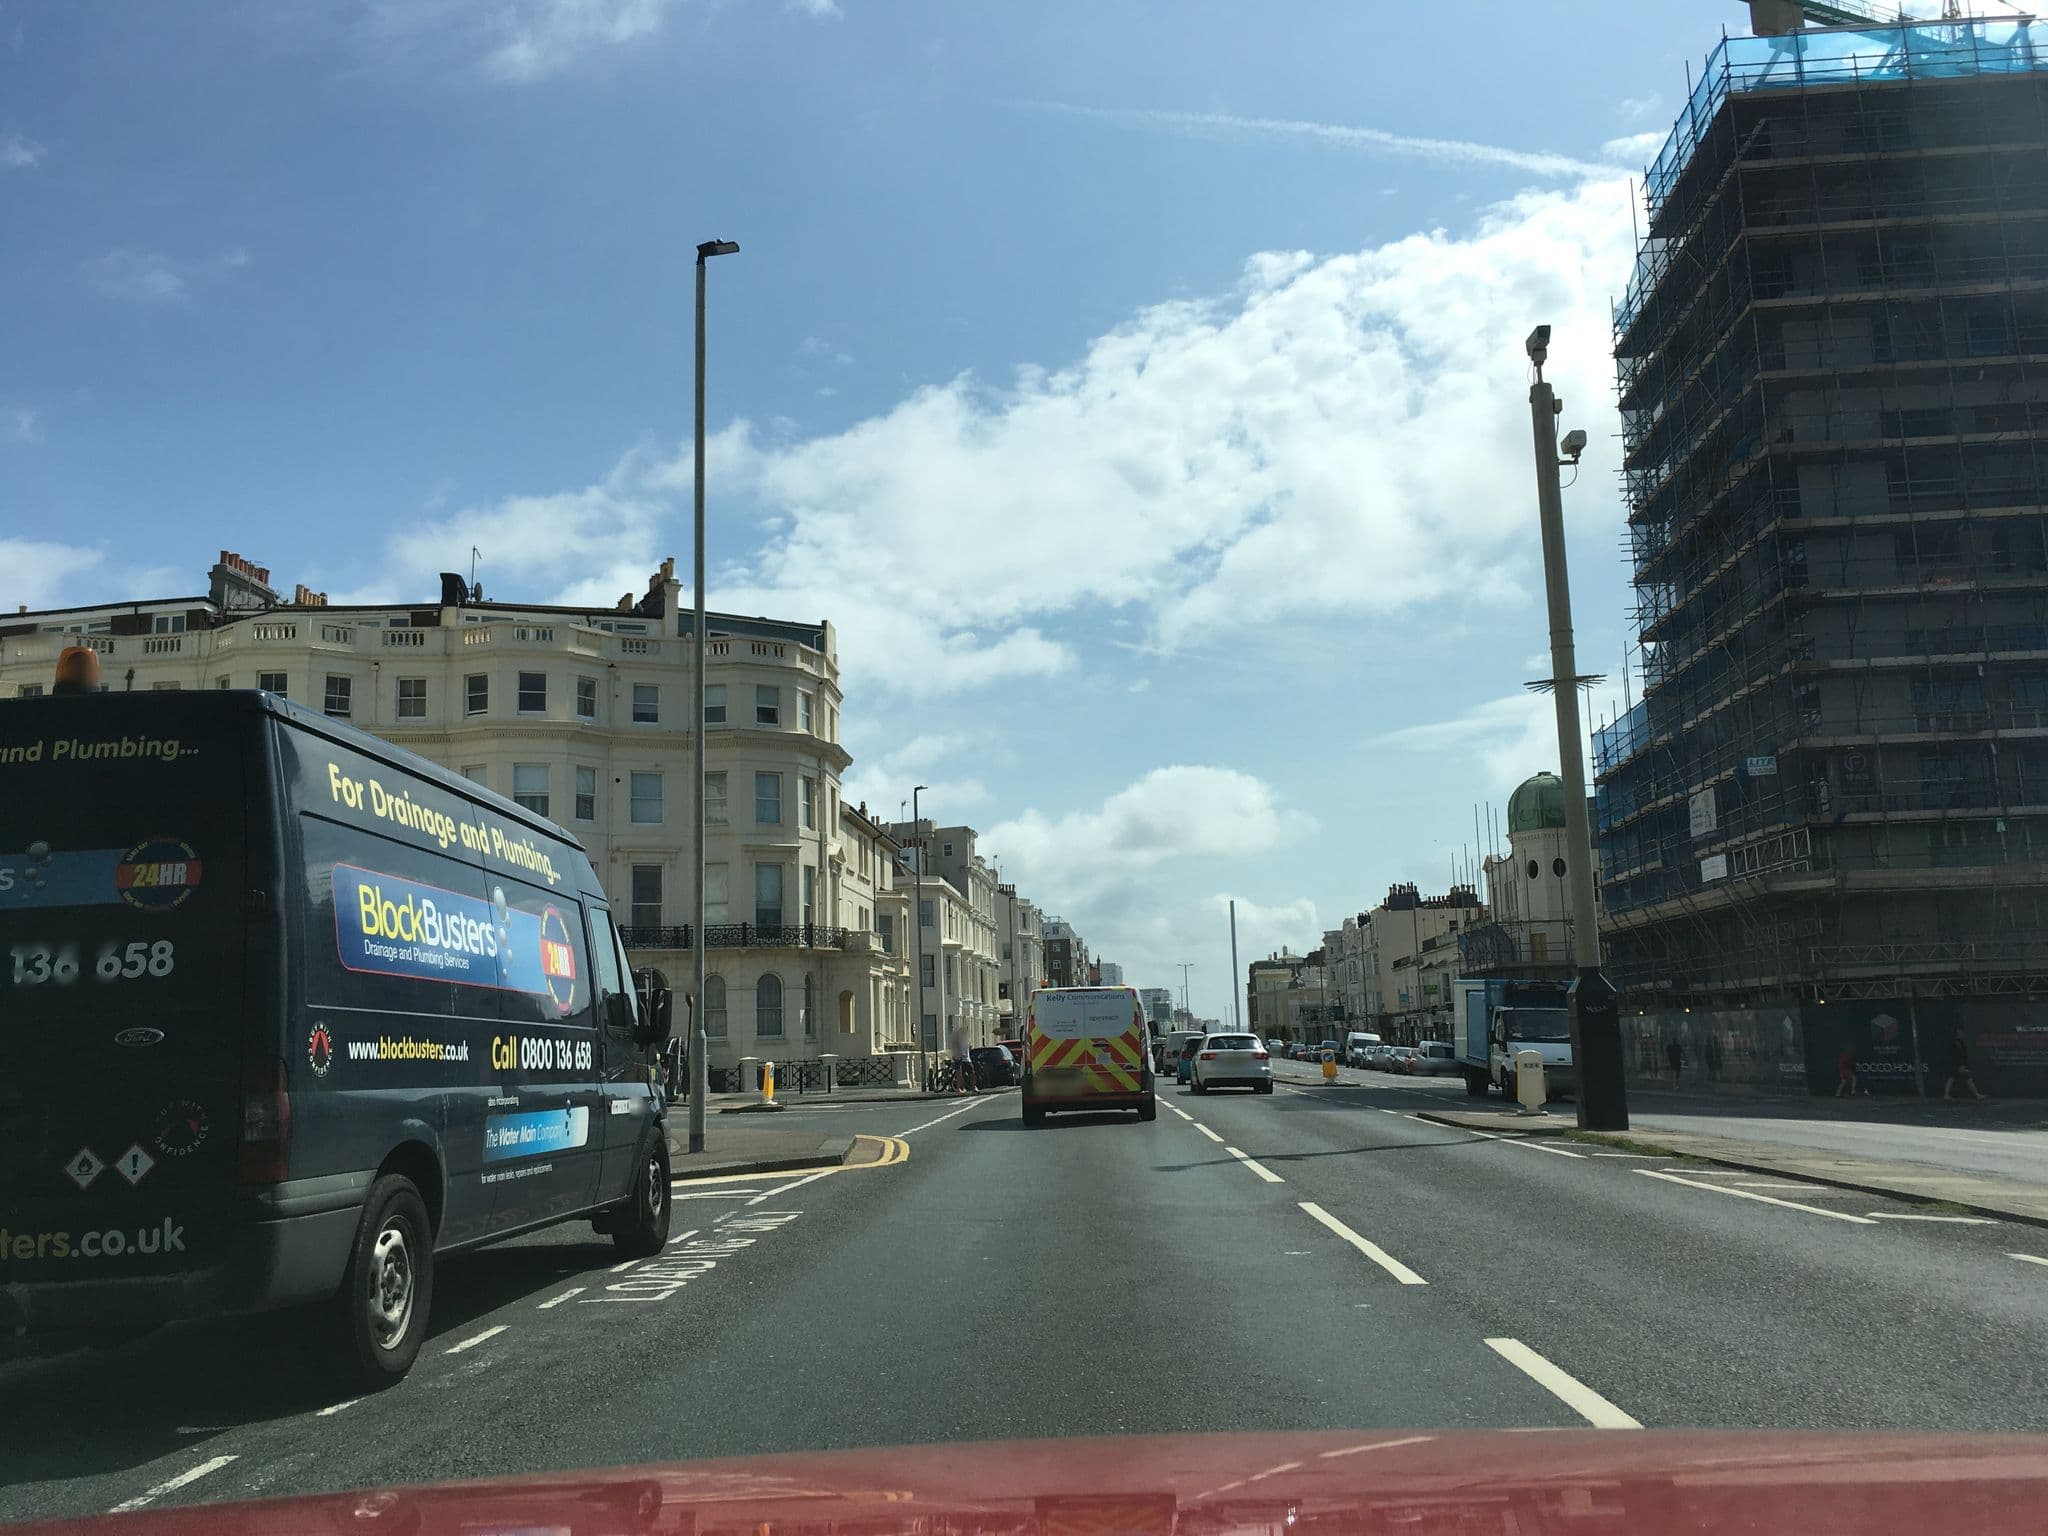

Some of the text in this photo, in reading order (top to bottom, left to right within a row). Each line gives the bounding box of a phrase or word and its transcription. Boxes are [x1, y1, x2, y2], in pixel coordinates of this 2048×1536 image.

[53, 736, 199, 761] Plumbing...
[328, 762, 562, 886] For Drainage and Plumbing...
[132, 863, 188, 887] 24HR
[357, 884, 498, 958] BlockBusters
[10, 940, 174, 984] 136 658
[364, 939, 470, 970] Drainage and Plumbing Services
[548, 942, 571, 976] 24HR
[1046, 994, 1065, 1003] Kelly
[1067, 993, 1125, 1001] Communications
[348, 1036, 469, 1061] www.blockbusters.co.uk
[492, 1035, 592, 1070] Call 0800 136 658
[486, 1128, 498, 1148] The
[499, 1126, 519, 1146] Water
[520, 1124, 537, 1143] Main
